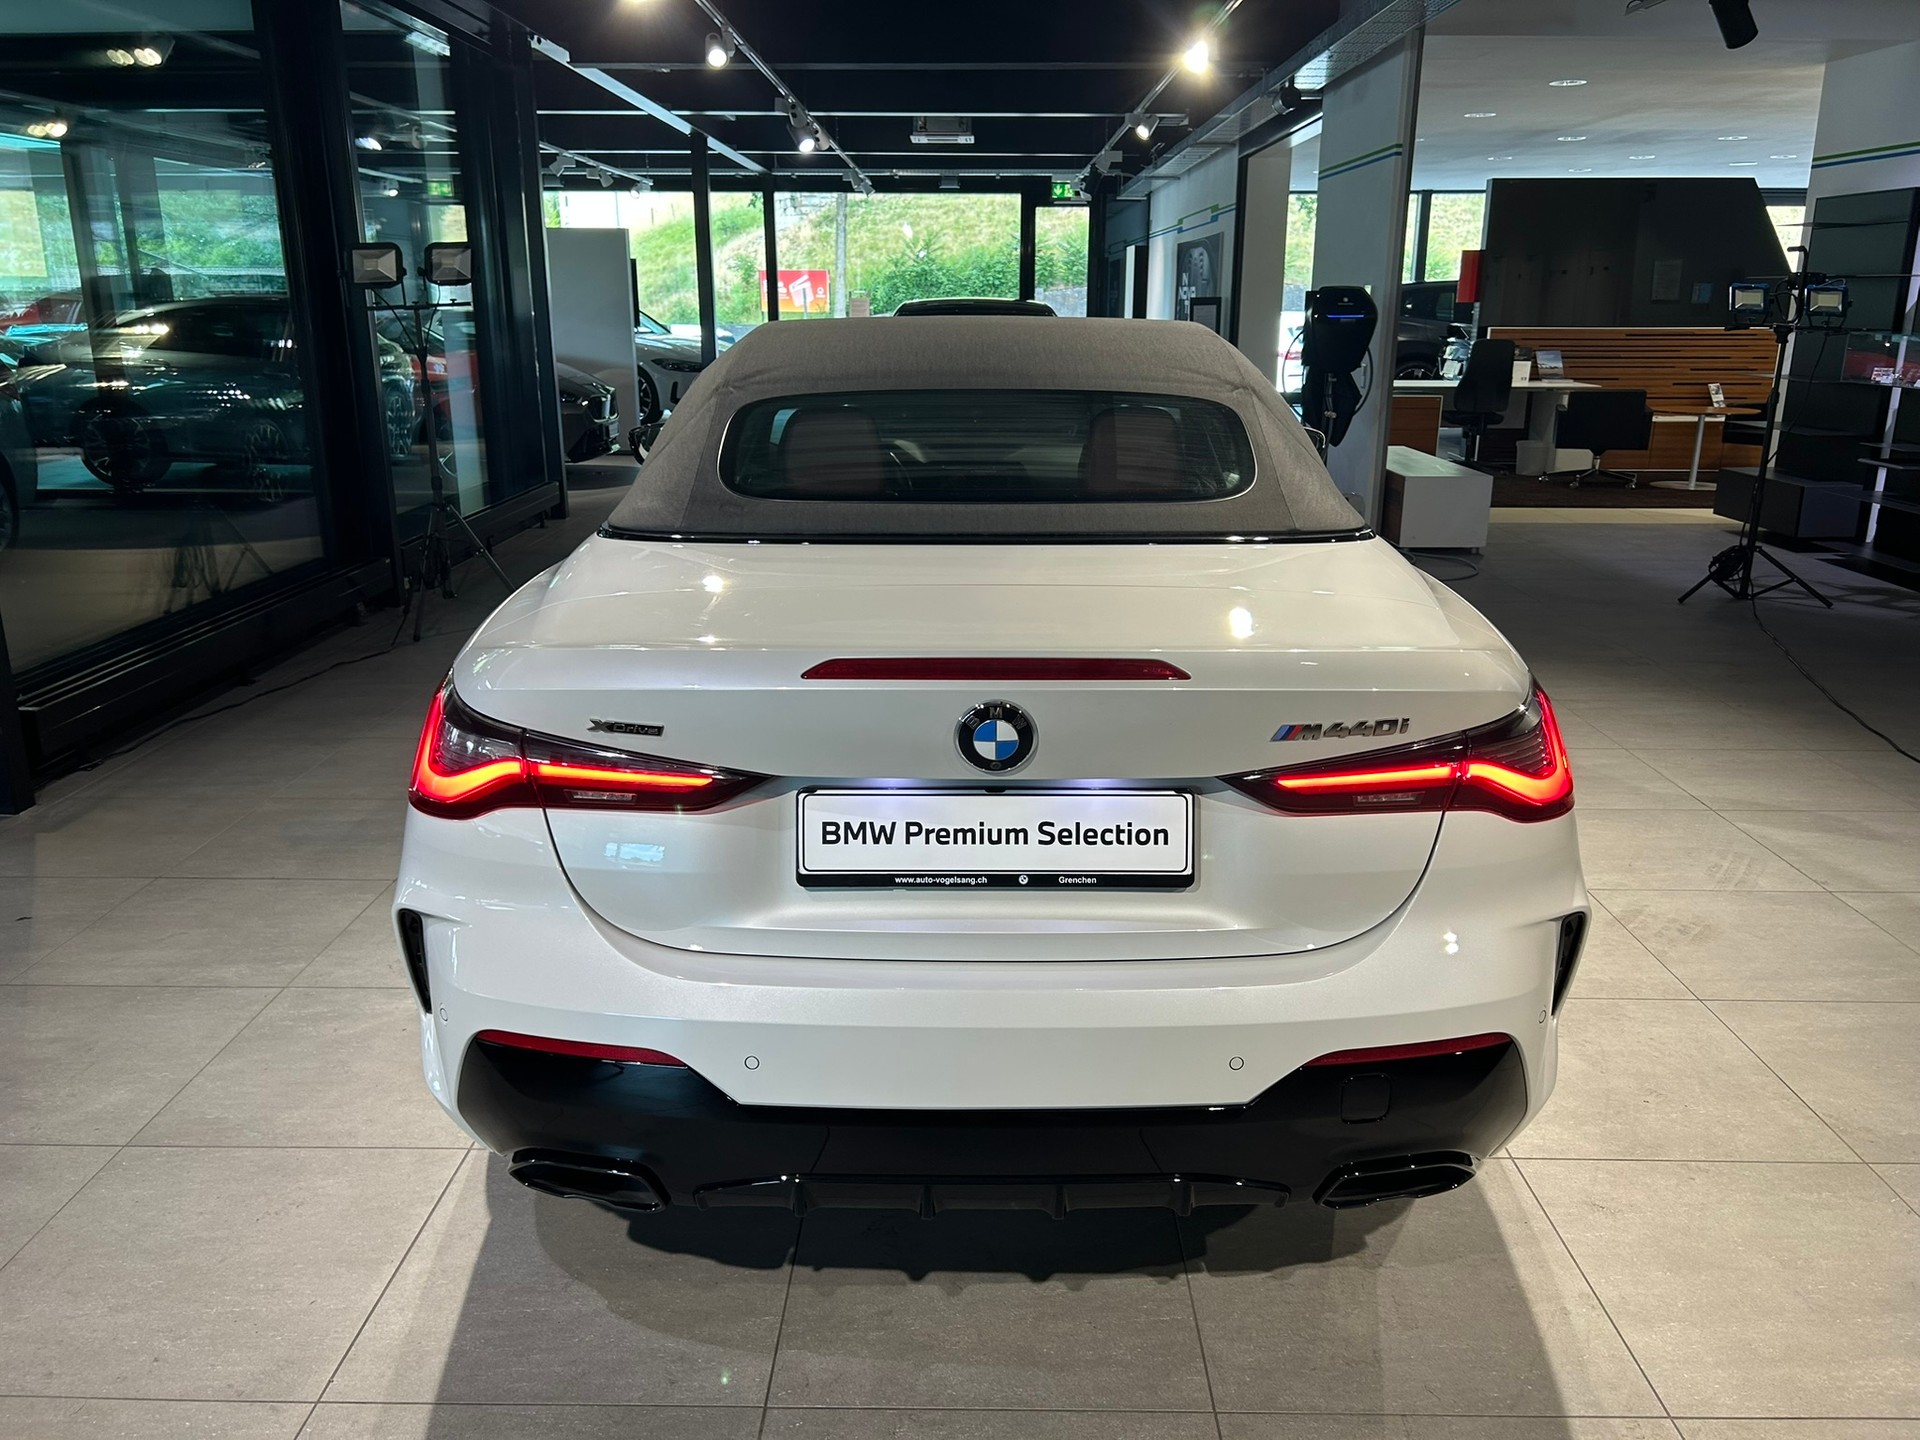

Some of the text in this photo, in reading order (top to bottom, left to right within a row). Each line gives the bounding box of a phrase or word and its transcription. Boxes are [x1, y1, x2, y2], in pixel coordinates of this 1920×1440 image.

[965, 706, 1028, 730] BMW
[1295, 717, 1410, 741] M440i
[821, 821, 1169, 846] BMW Premium Selection
[894, 875, 1097, 886] www.auto-vogelsang.ch Grenchen
